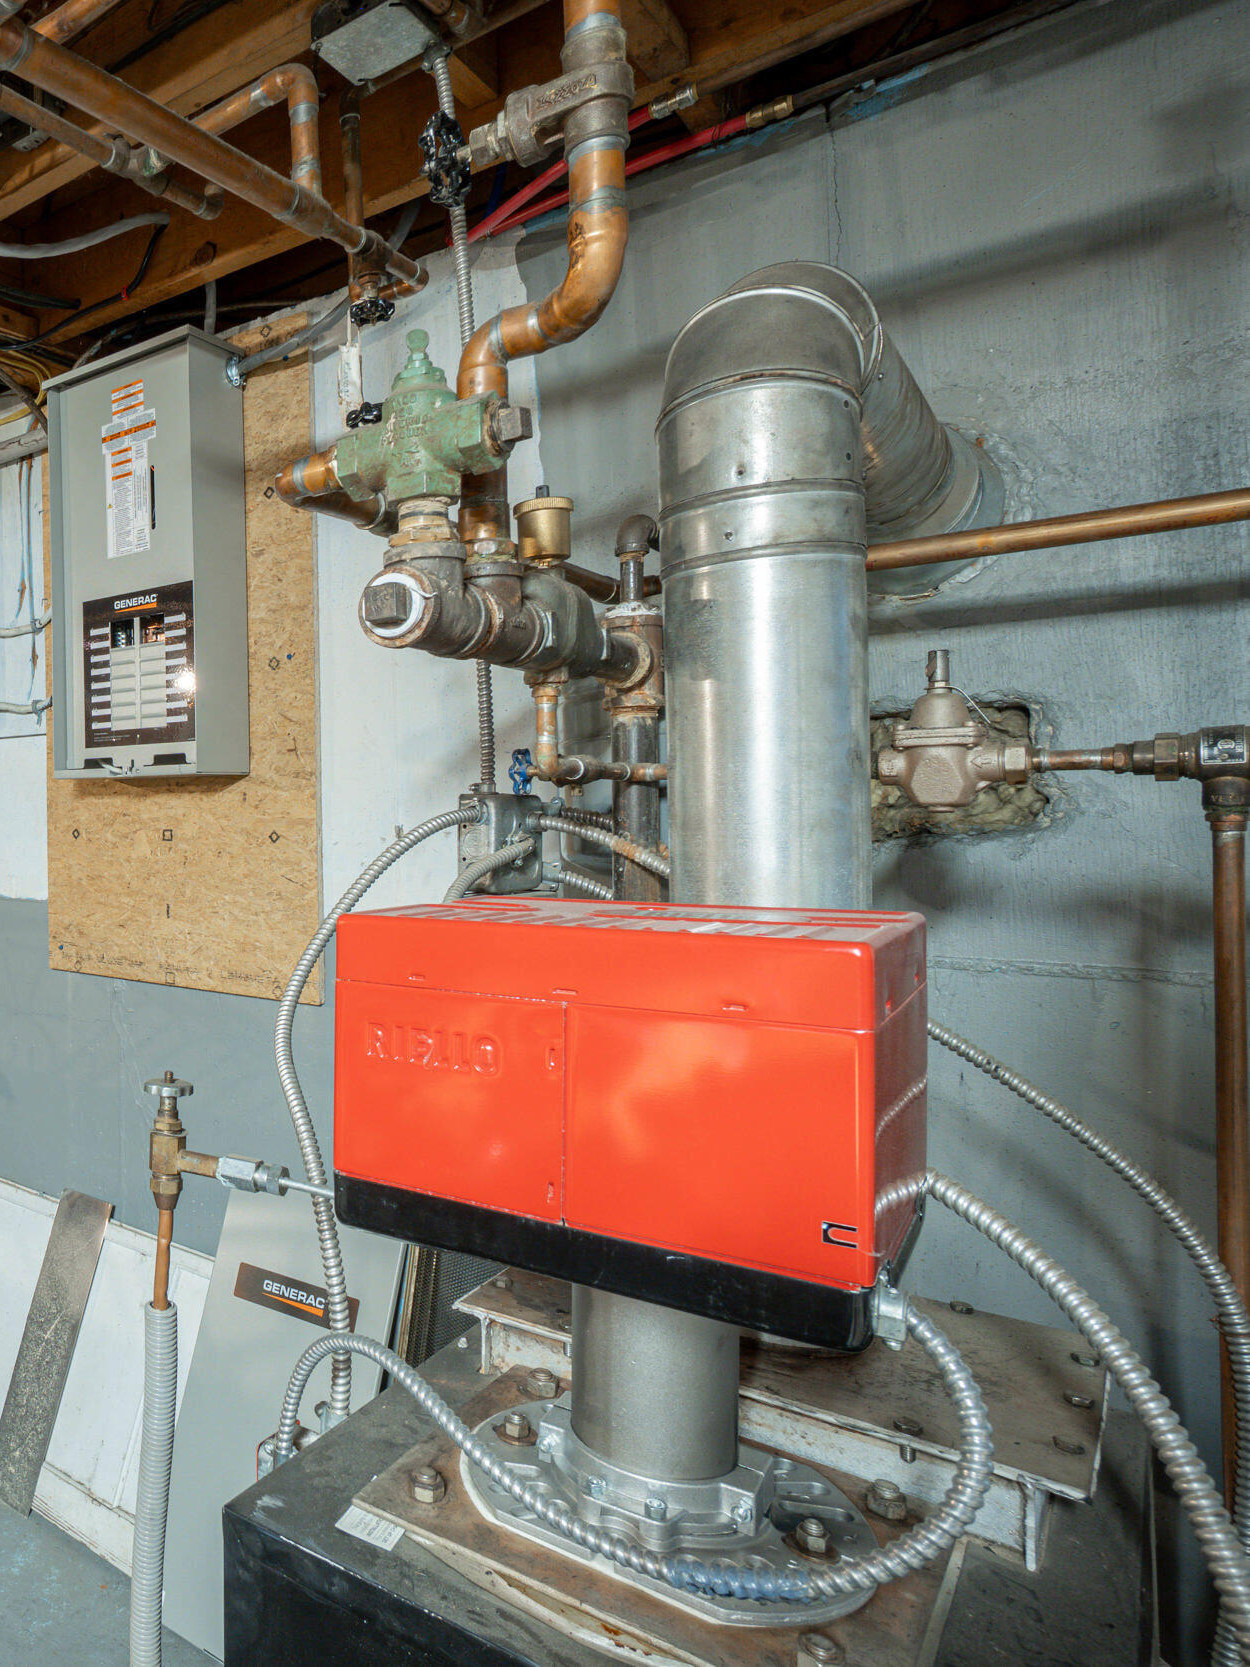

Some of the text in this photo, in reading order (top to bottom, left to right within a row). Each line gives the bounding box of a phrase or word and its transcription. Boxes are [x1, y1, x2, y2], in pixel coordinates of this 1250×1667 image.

[114, 593, 157, 610] GENERAC
[366, 1021, 502, 1076] RIELLO
[263, 1279, 326, 1310] GENERAC
